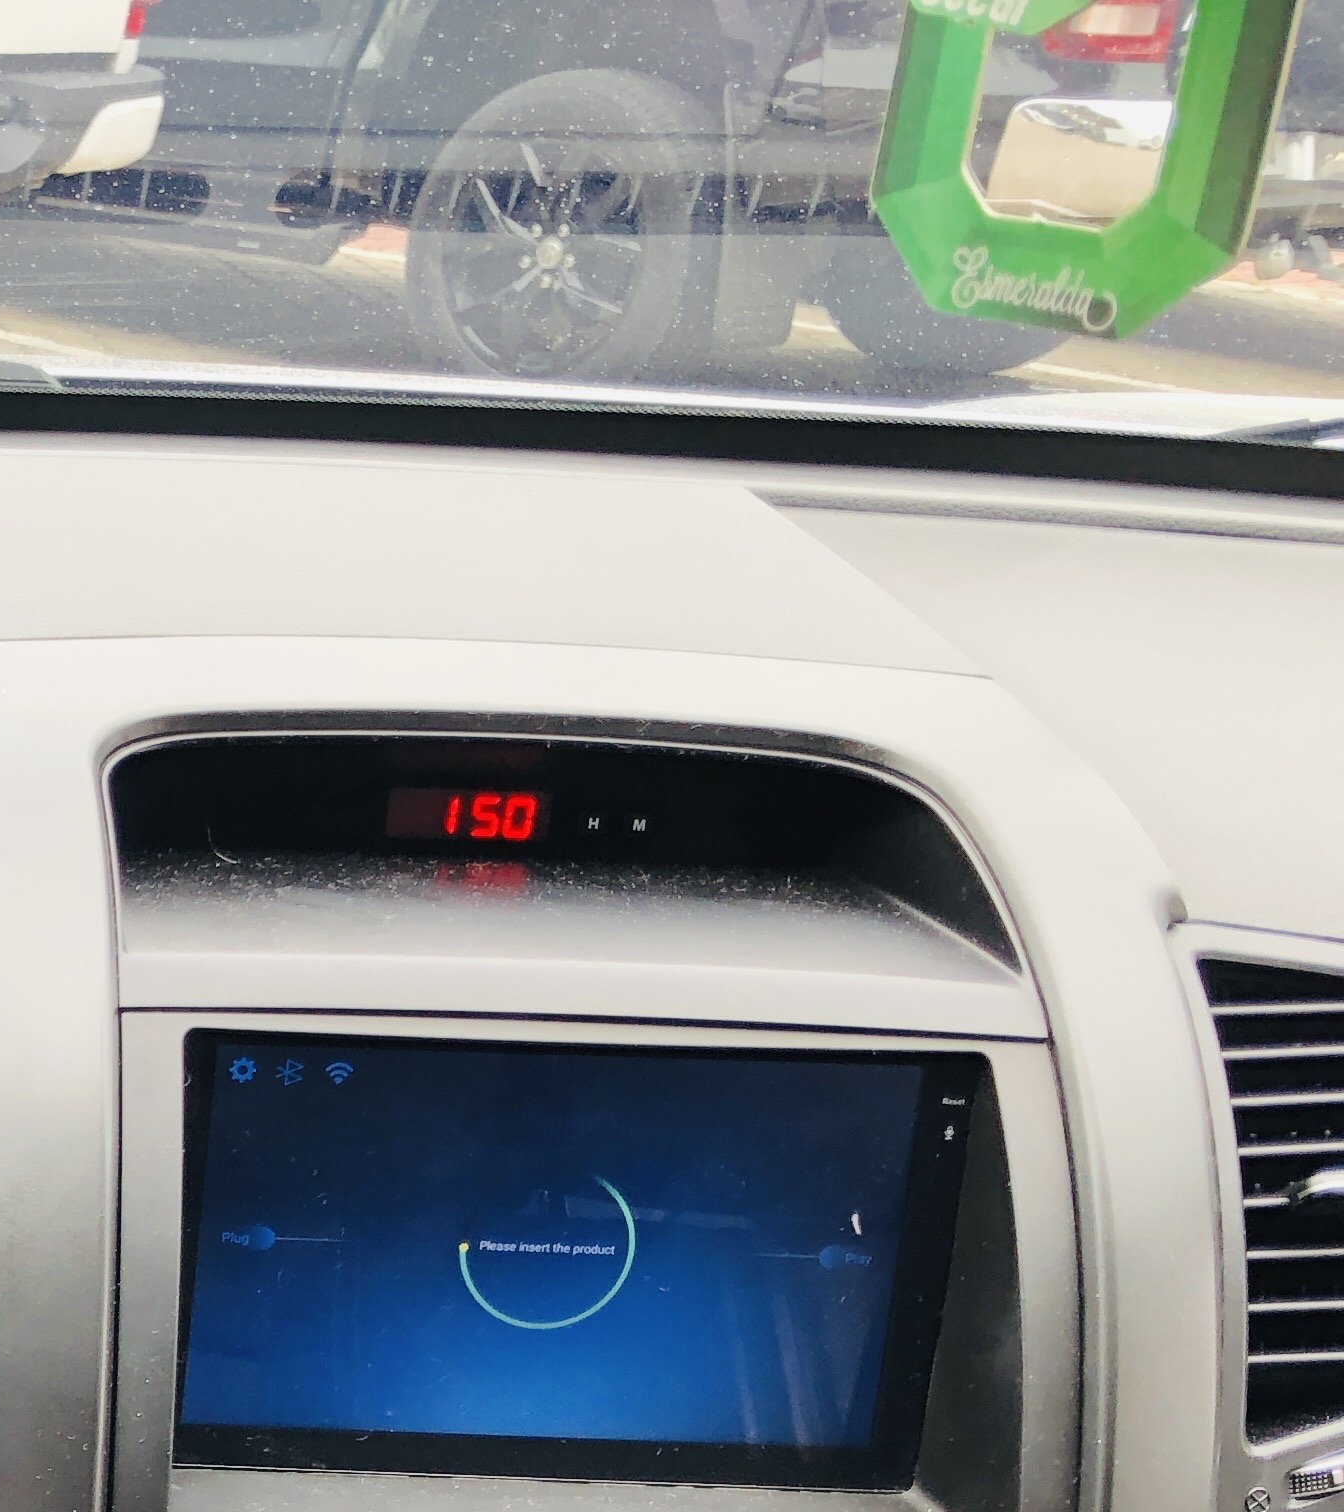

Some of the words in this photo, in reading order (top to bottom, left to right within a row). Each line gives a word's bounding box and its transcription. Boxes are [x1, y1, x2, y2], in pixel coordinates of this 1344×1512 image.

[951, 246, 1118, 331] Esmeralda
[587, 817, 600, 830] H
[632, 818, 646, 832] M
[222, 1232, 250, 1247] Plug
[479, 1240, 517, 1252] Please
[519, 1242, 551, 1253] insert
[553, 1243, 570, 1253] the
[572, 1245, 616, 1256] product
